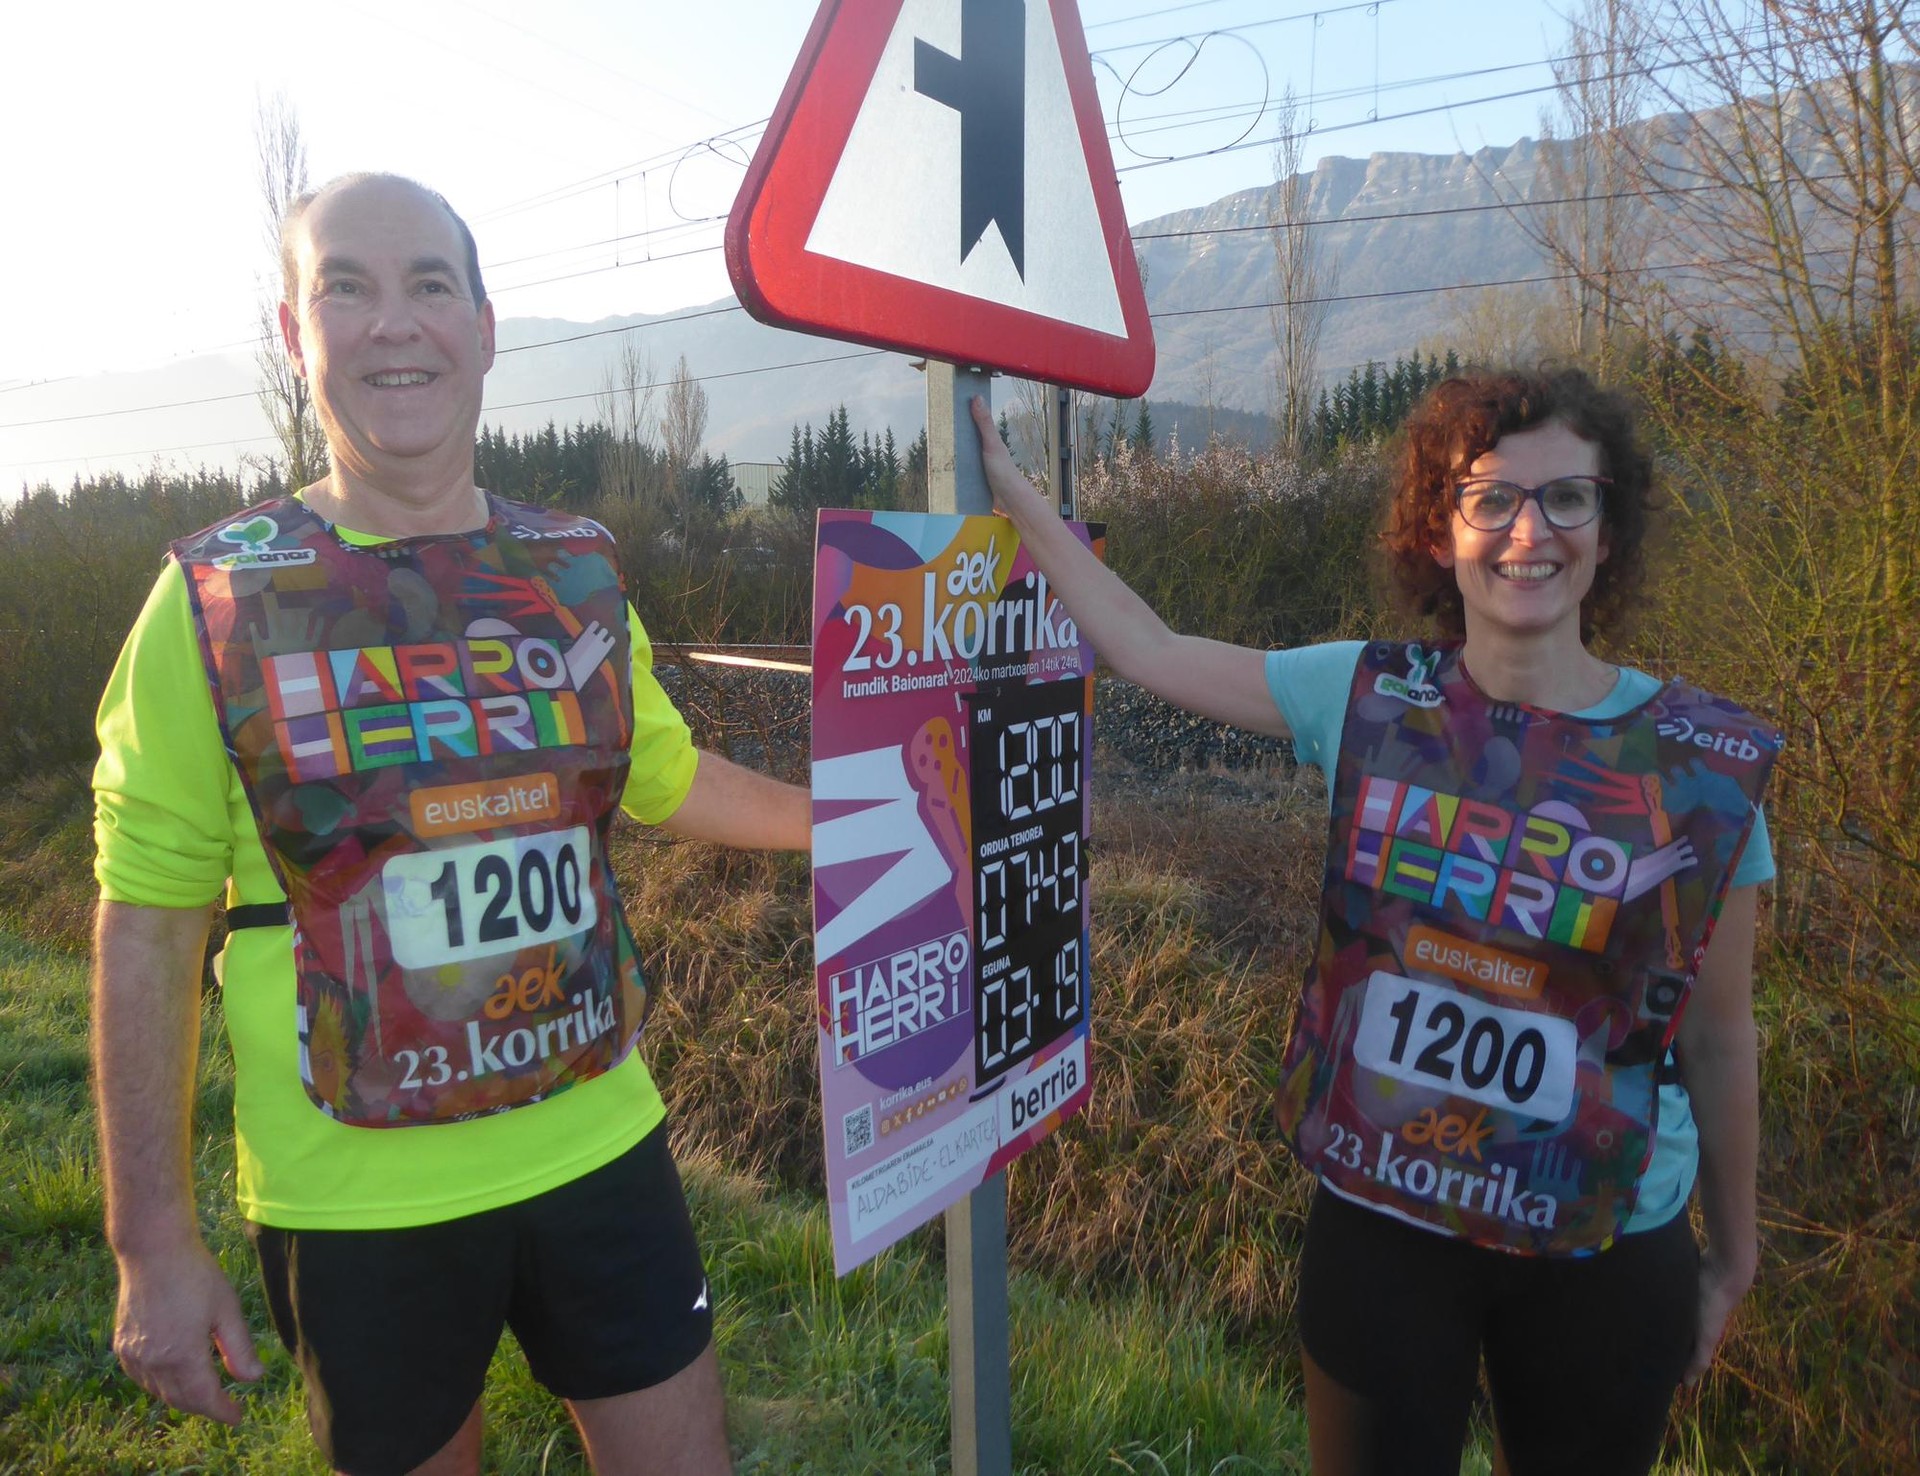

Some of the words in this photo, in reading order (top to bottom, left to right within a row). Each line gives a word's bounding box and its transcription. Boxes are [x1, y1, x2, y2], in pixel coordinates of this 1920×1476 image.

[947, 534, 1001, 596] aek
[843, 675, 889, 698] Irundik
[892, 673, 949, 692] Baionarat
[954, 665, 990, 685] 2024ko
[991, 662, 1039, 680] martxoaren
[1041, 658, 1060, 673] 14tik
[1061, 656, 1078, 671] 24ra
[977, 708, 992, 723] KM
[999, 711, 1079, 821] 1200
[1694, 726, 1759, 763] eitb
[425, 782, 552, 825] euskaltel
[980, 835, 1009, 858] ORDUA
[1010, 825, 1044, 849] TENOREA
[431, 842, 582, 949] 1200
[980, 831, 1079, 951] 07:43
[483, 945, 568, 1020] aek
[831, 932, 969, 1023] HARRO
[982, 955, 1011, 979] EGUNA
[1415, 937, 1536, 989] euskaltel
[1388, 989, 1547, 1104] 1200
[879, 1076, 932, 1112] korrika.eus
[1011, 1057, 1077, 1131] berria
[1401, 1106, 1495, 1163] aek
